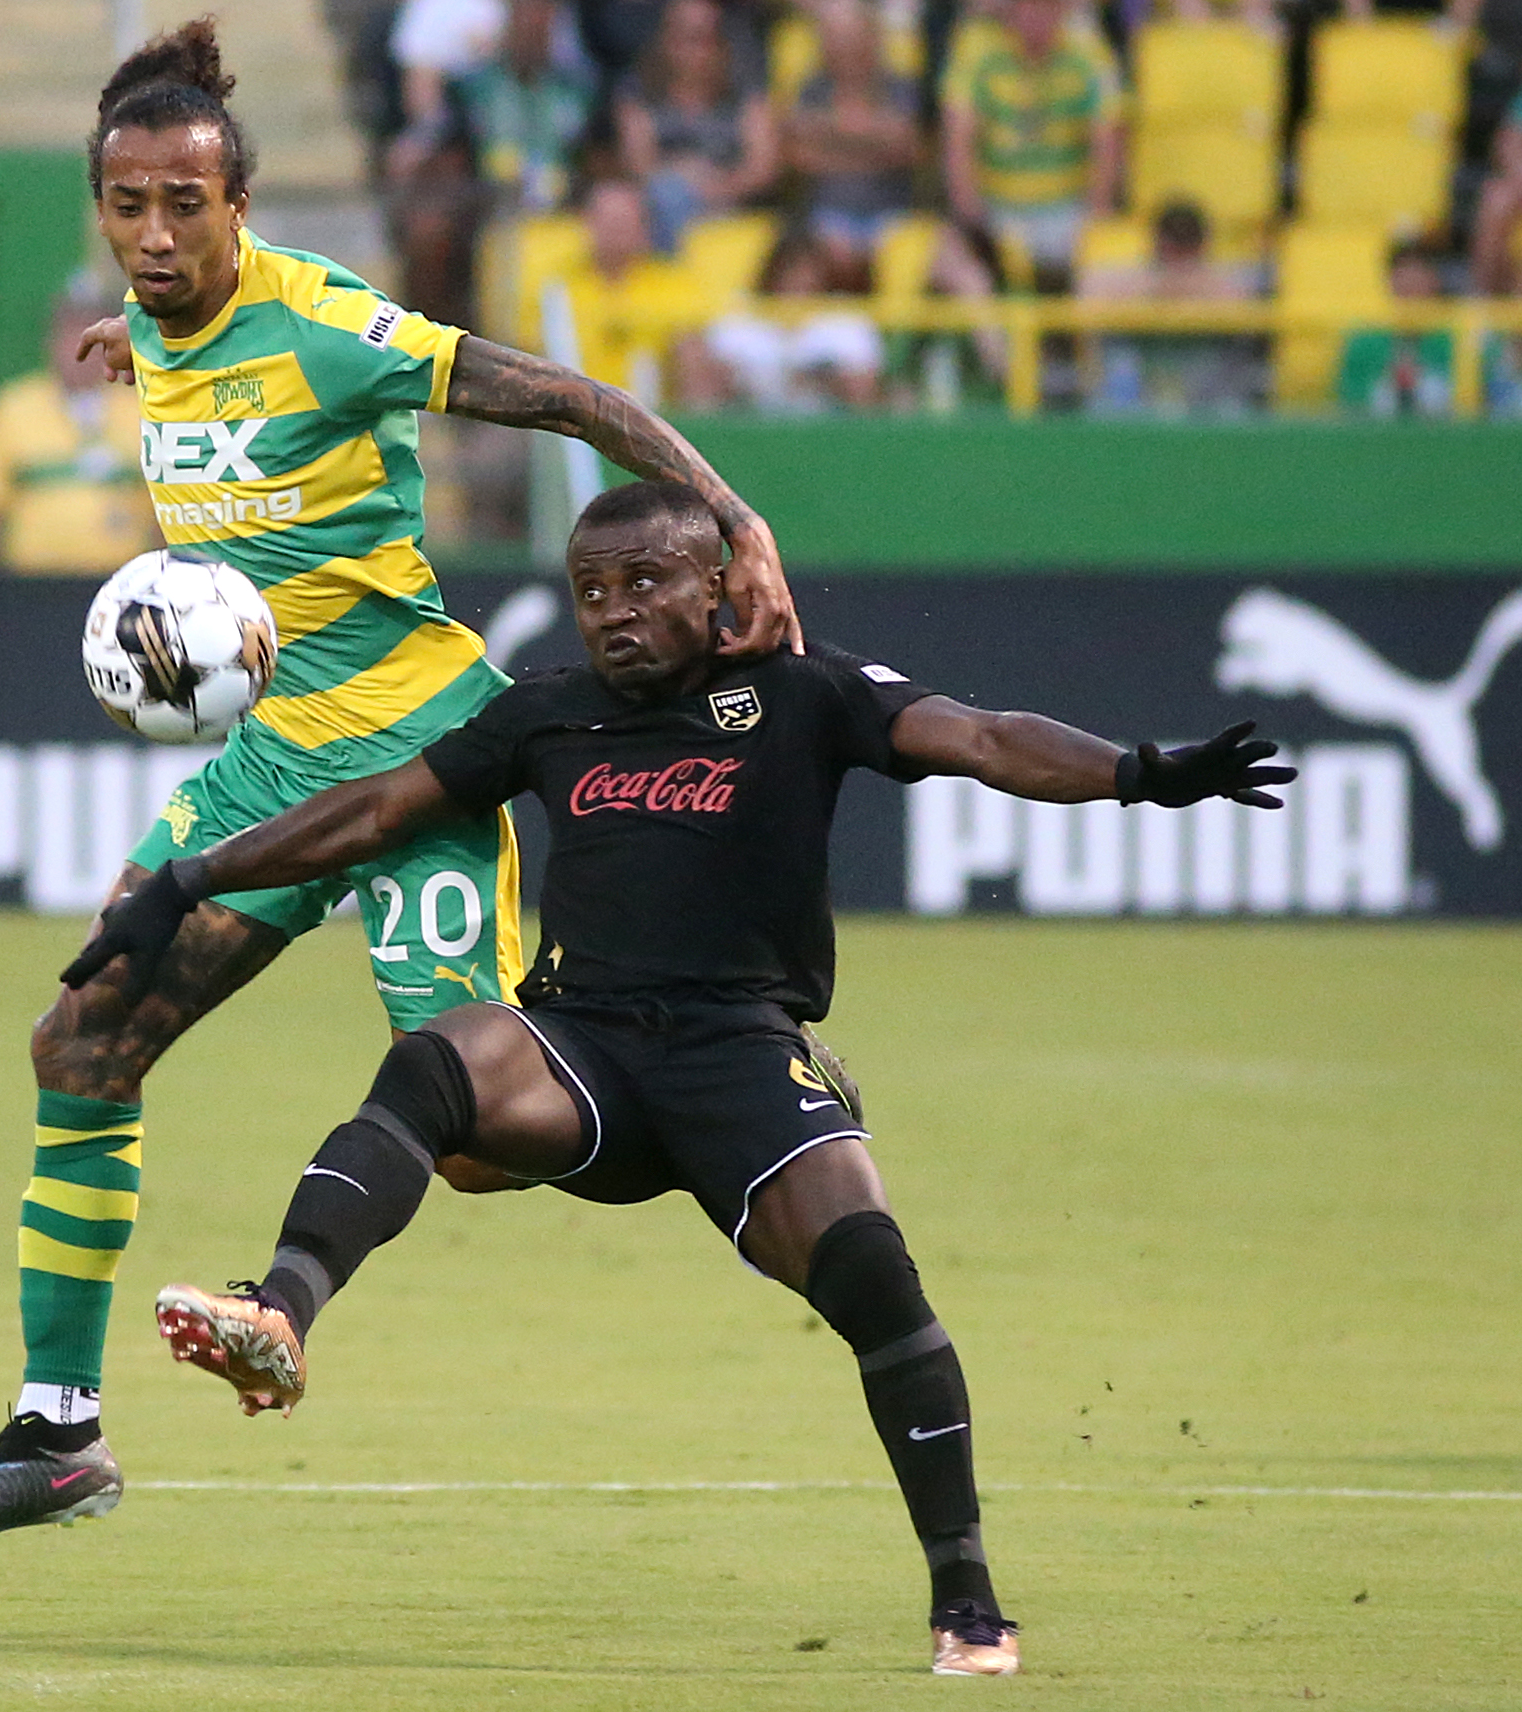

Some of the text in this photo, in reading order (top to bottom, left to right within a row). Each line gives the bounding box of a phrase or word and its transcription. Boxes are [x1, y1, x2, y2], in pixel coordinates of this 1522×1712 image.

[152, 486, 302, 530] maging
[569, 757, 746, 816] Coca-Cola
[906, 742, 1413, 915] PUMA
[370, 870, 482, 962] 20
